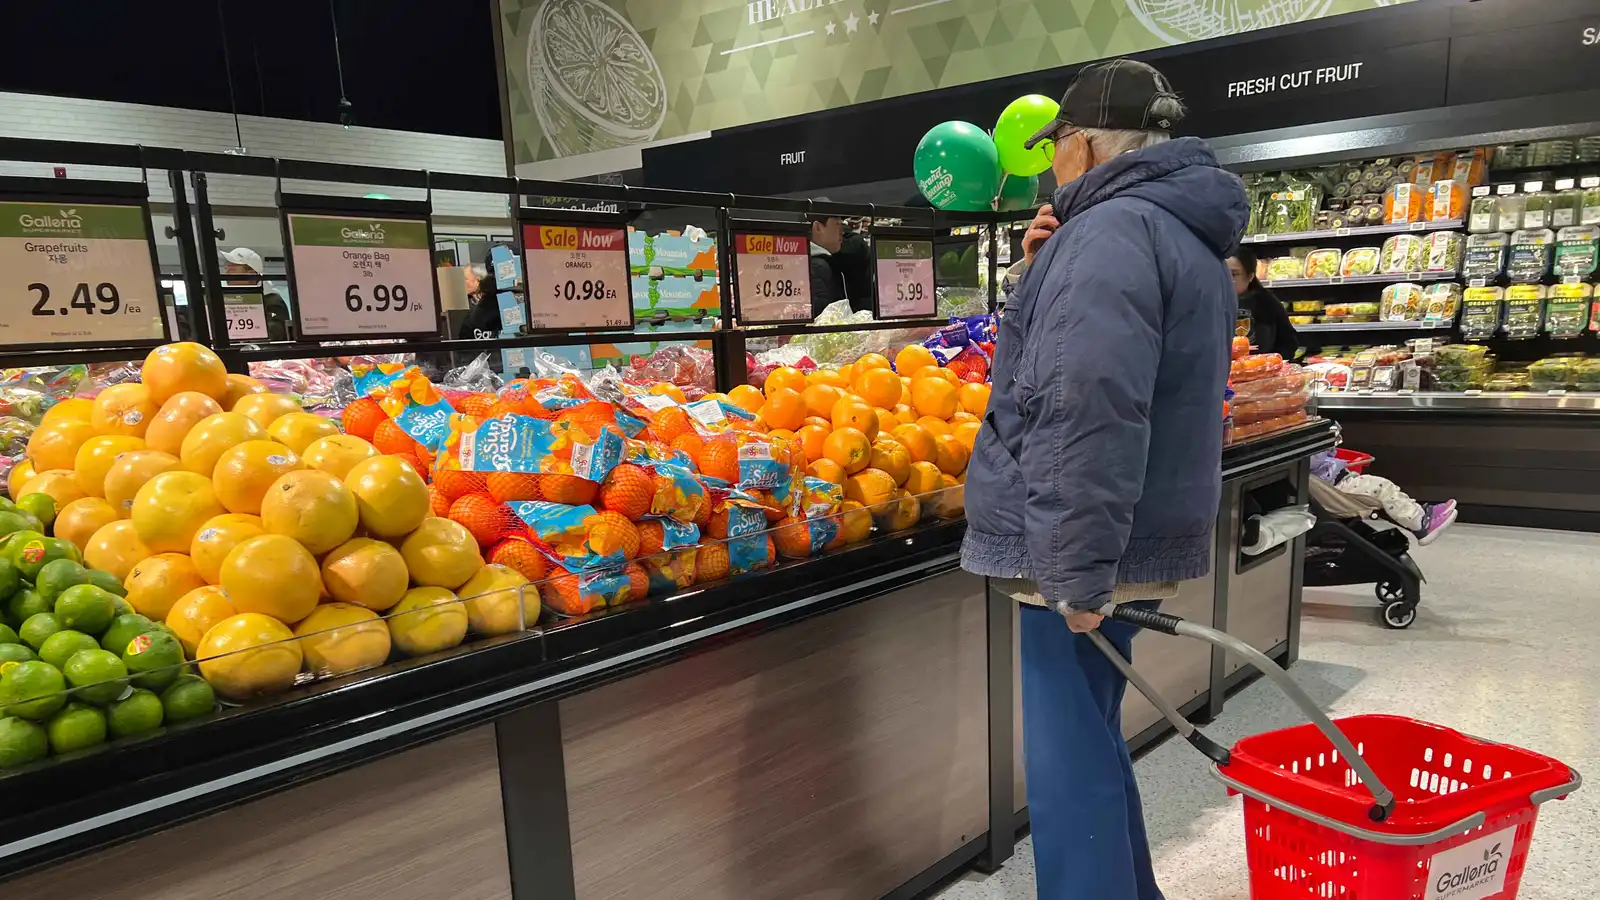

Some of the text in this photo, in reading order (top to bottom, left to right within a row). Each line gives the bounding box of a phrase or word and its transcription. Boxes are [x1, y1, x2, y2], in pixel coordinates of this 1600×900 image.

[1228, 62, 1363, 98] FRESH CUT FRUIT
[780, 150, 806, 165] FRUIT
[924, 173, 953, 200] pening
[19, 214, 83, 228] Galleria
[340, 227, 386, 239] Galleria
[545, 229, 614, 248] Sale Now
[24, 242, 88, 254] Grapefruits
[749, 236, 799, 253] Sale Now
[342, 250, 390, 261] Orange Bag
[27, 282, 141, 316] 2.49 /ea
[345, 284, 423, 312] 6.99 /pk
[896, 283, 923, 301] 5.99
[226, 318, 254, 330] 7.99
[483, 420, 501, 454] Sun
[492, 412, 518, 472] Candy
[752, 468, 778, 481] Sun
[740, 512, 761, 528] Sun
[1436, 858, 1498, 893] Galleria
[1435, 874, 1496, 900] SUPERMARKET
